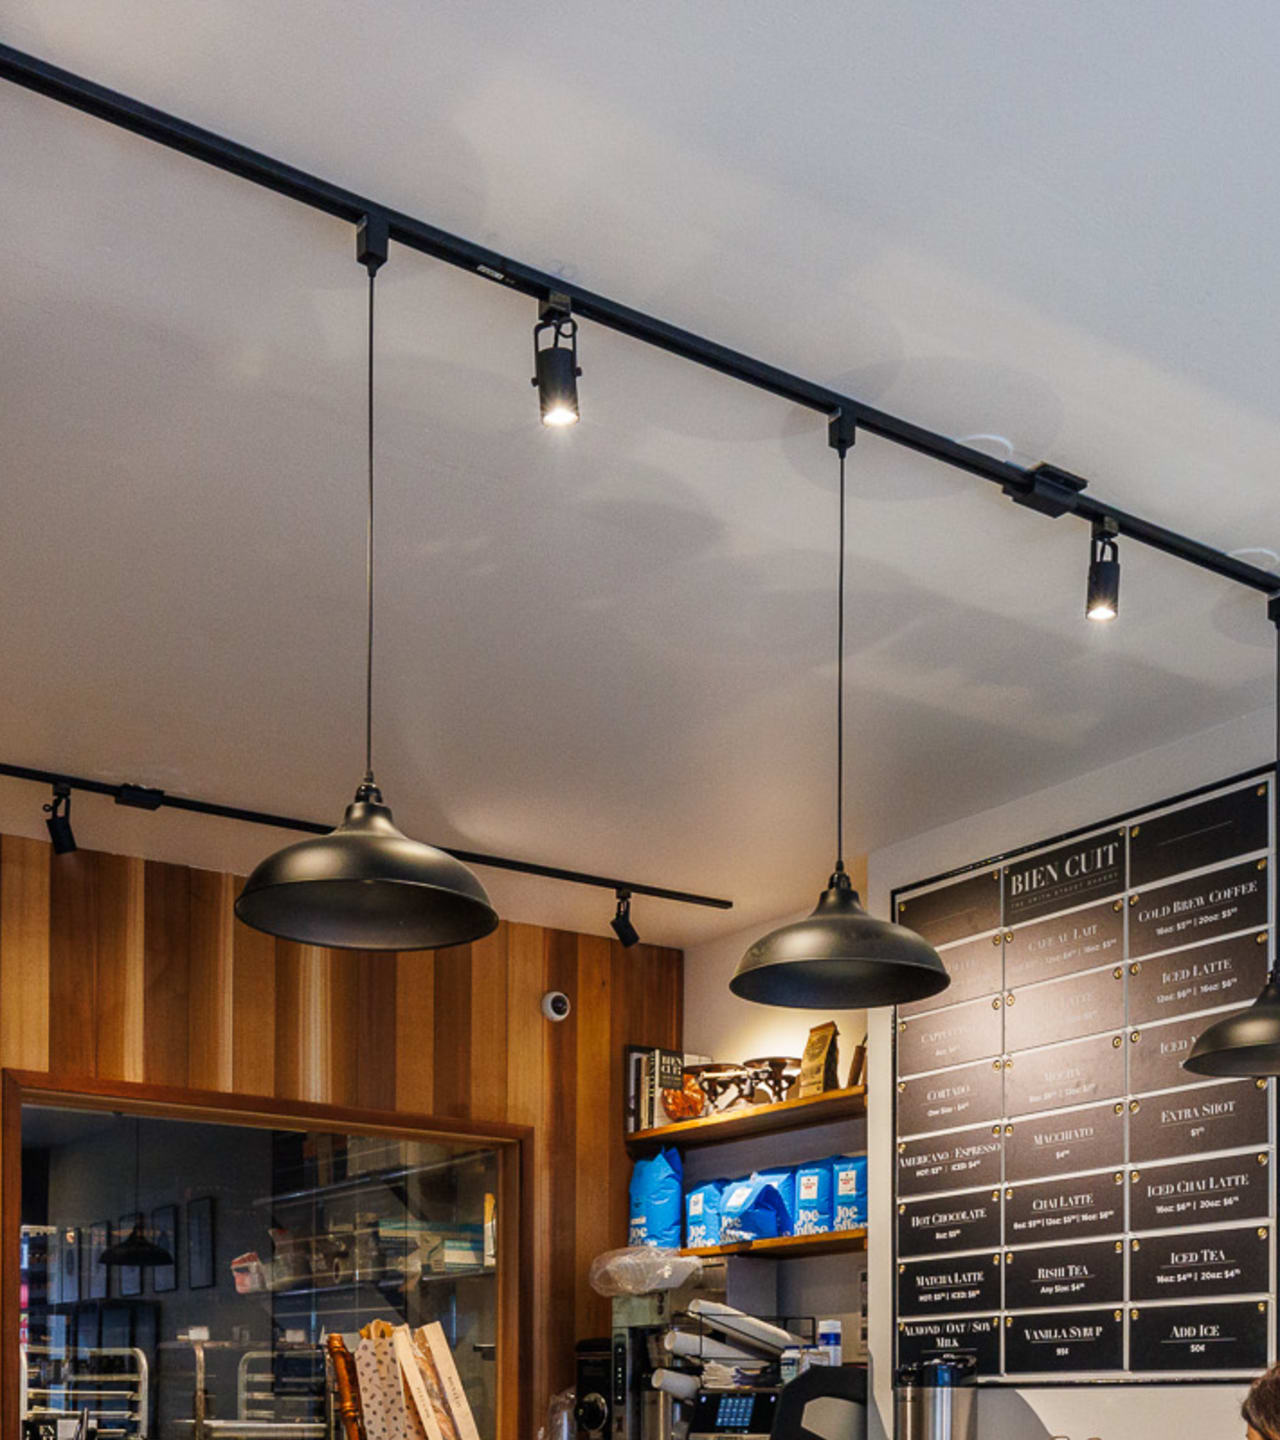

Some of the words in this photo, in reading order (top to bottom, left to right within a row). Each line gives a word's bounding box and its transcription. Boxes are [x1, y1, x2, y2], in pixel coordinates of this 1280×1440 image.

[1011, 863, 1058, 896] BIEN
[1064, 841, 1119, 878] CUIT
[1139, 906, 1171, 922] COLD
[1173, 896, 1206, 913] BREW
[1209, 881, 1258, 903] COFFEE
[1162, 968, 1191, 984] ICED
[1192, 959, 1233, 977] LATTE
[1161, 1107, 1200, 1124] EXTRA
[1201, 1100, 1236, 1117] SHOT
[1034, 1127, 1095, 1146] MACCHIATO
[1147, 1184, 1175, 1198] ICED
[1176, 1179, 1207, 1195] CHAI
[1208, 1173, 1250, 1190] LATTE
[1032, 1197, 1058, 1211] CHAI
[1059, 1193, 1095, 1207] LATTE
[911, 1214, 931, 1228] HOT
[932, 1207, 988, 1224] CHOCOLATE
[1171, 1251, 1198, 1265] ICED
[1200, 1248, 1226, 1263] TEA
[915, 1274, 953, 1288] MATCHA
[954, 1270, 986, 1285] LATTE
[1037, 1267, 1065, 1279] RISHI
[1067, 1265, 1090, 1278] TEA
[904, 1325, 940, 1337] ALMOND
[945, 1322, 966, 1334] OAT
[970, 1320, 992, 1333] SOY
[1024, 1327, 1068, 1341] VANILLA
[1068, 1325, 1104, 1339] SYRUP
[1170, 1326, 1197, 1339] ADD
[1199, 1324, 1221, 1338] ICE
[935, 1336, 960, 1349] MILK
